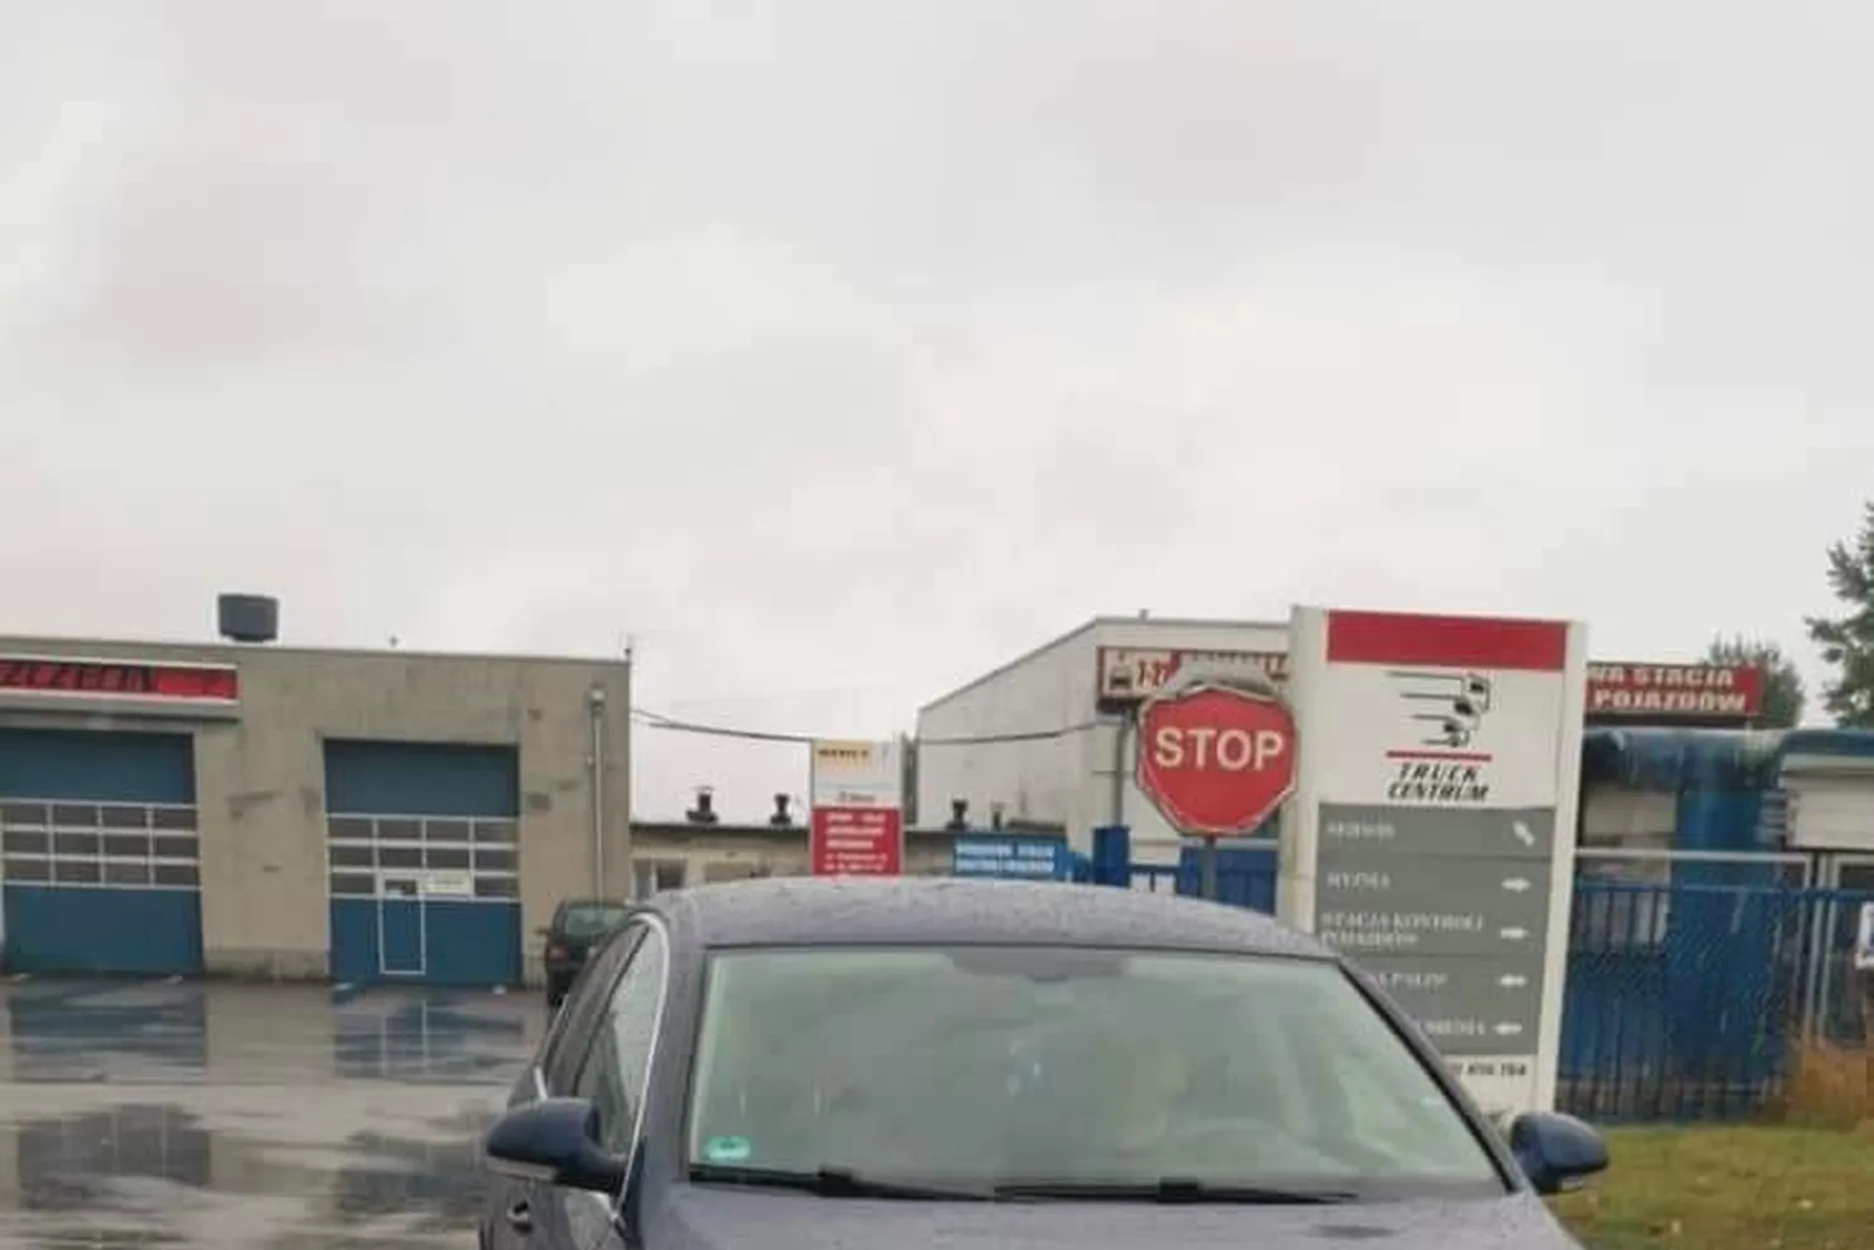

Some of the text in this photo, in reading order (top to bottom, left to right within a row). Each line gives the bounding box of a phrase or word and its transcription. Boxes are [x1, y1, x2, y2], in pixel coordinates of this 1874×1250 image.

[1155, 726, 1285, 771] STOP
[1399, 763, 1479, 782] TRUCK
[1387, 782, 1490, 802] CENTRUM
